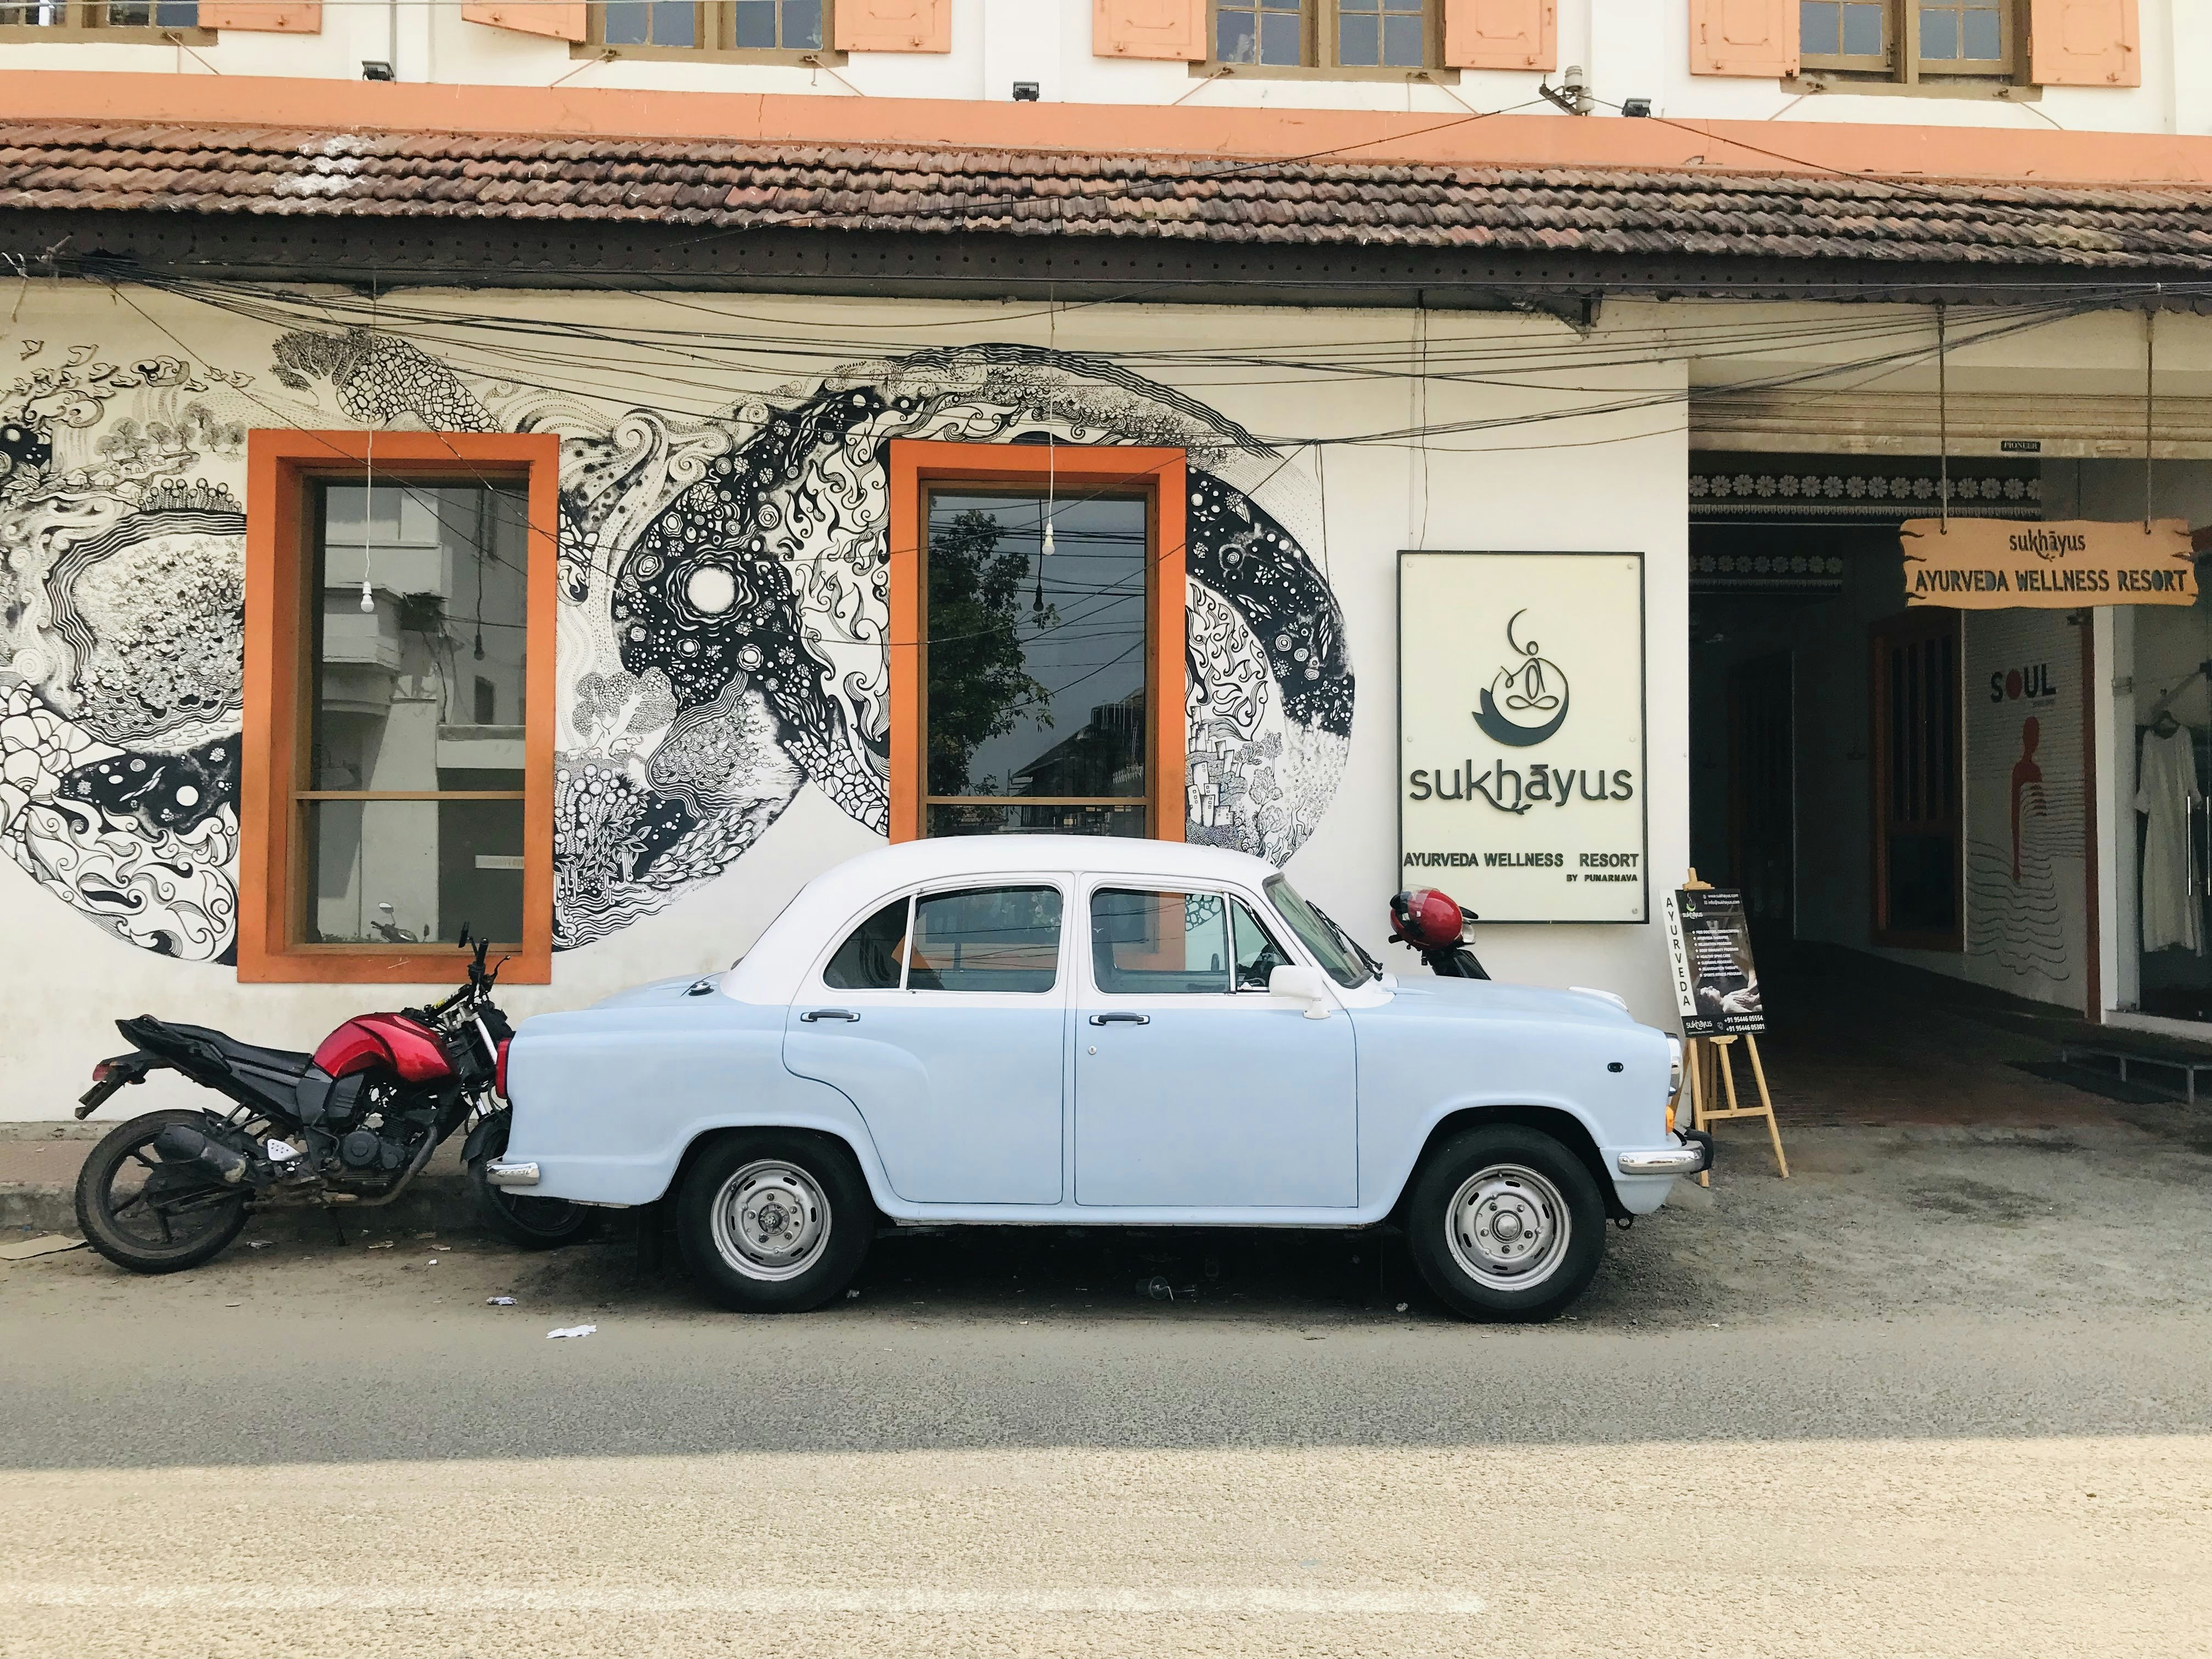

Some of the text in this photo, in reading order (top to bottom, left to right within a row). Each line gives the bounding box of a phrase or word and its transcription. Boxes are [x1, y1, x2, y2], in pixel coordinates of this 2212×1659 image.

[2010, 529, 2085, 562] sukhāyus
[1915, 569, 2187, 591] AYURVEDA WELLNESS RESORT
[1990, 663, 2057, 703] SOUL
[1409, 759, 1633, 815] sukhāyus
[1403, 853, 1639, 867] AYURVEDA WELLNESS RESORT
[1666, 898, 1690, 1006] AYURVEDA
